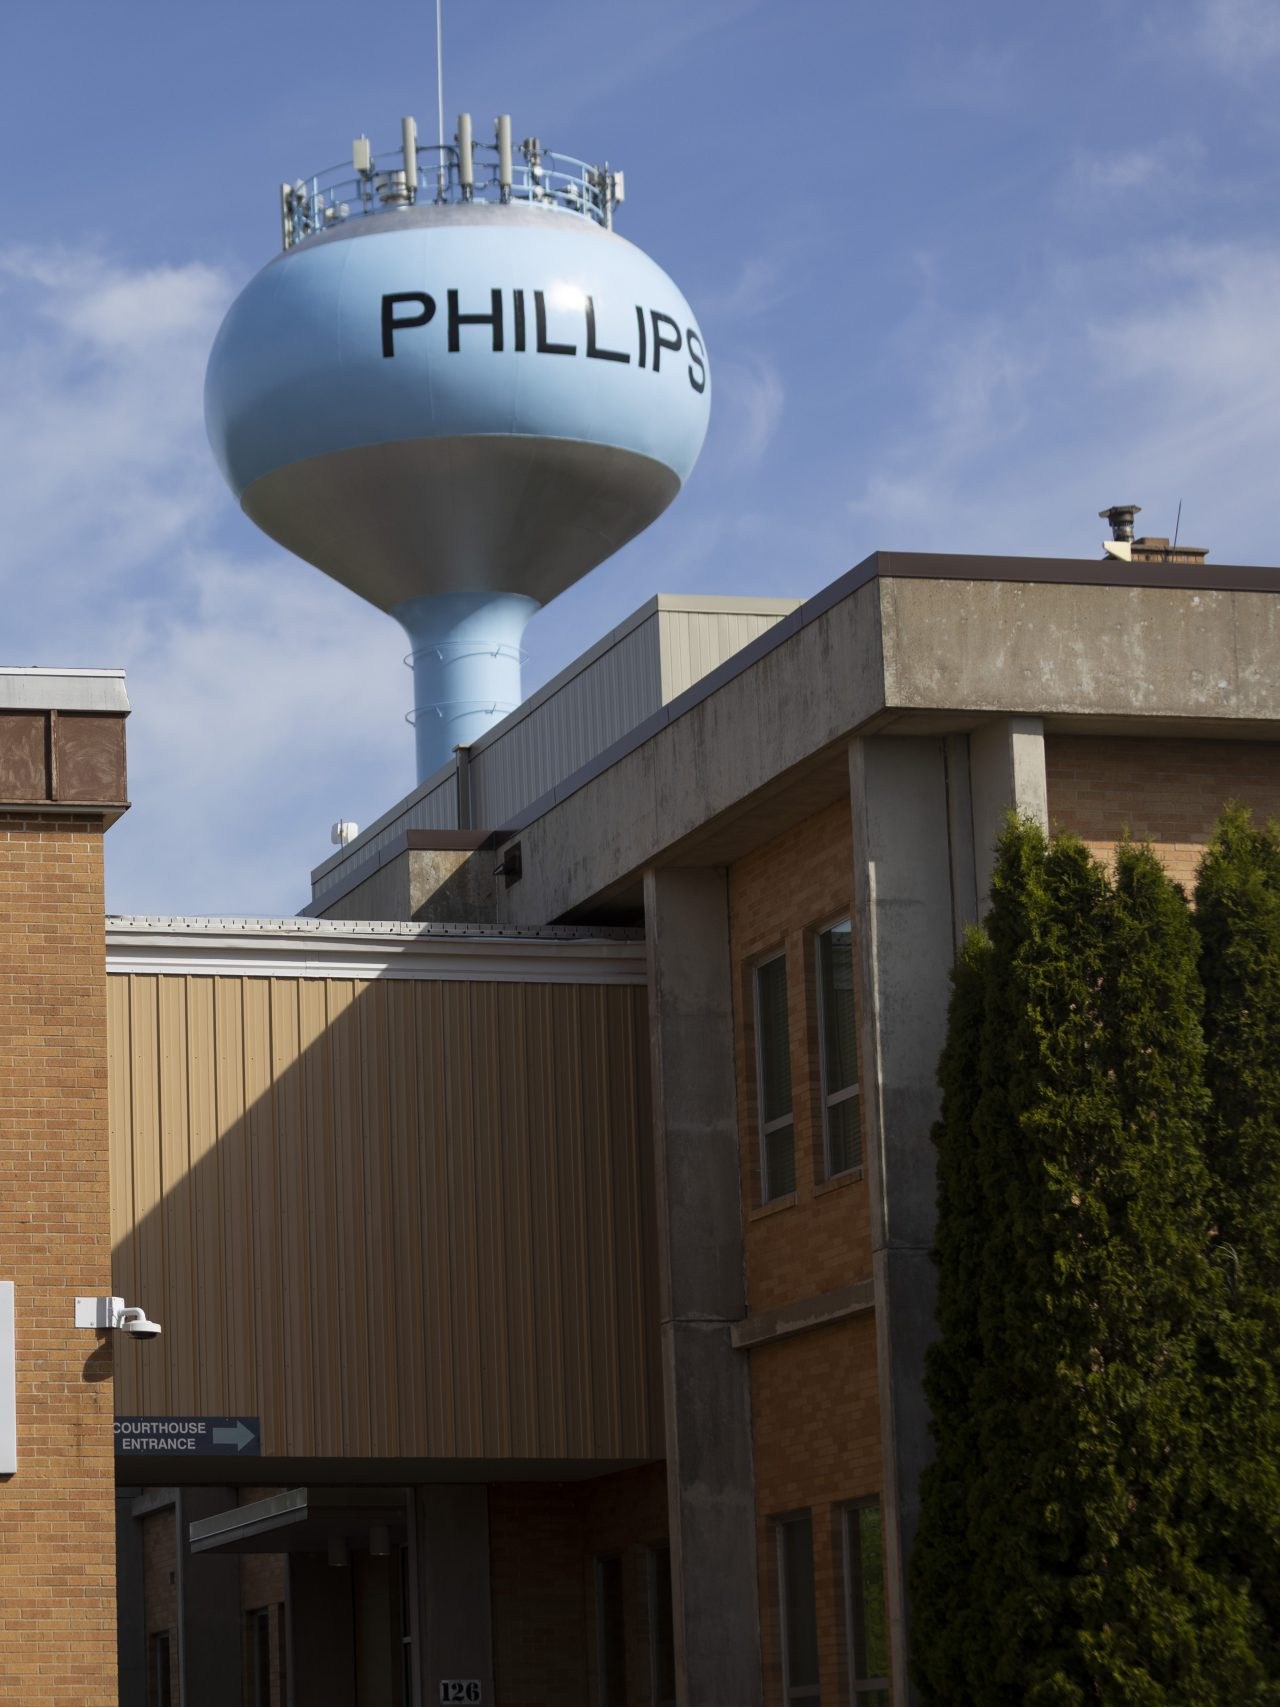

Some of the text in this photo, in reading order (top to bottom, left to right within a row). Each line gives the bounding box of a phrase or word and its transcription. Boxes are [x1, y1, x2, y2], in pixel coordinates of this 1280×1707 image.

[381, 288, 706, 394] PHILLIPS
[113, 1422, 207, 1434] COURTHOUSE
[122, 1438, 196, 1450] ENTRANCE
[441, 1682, 480, 1702] 126
